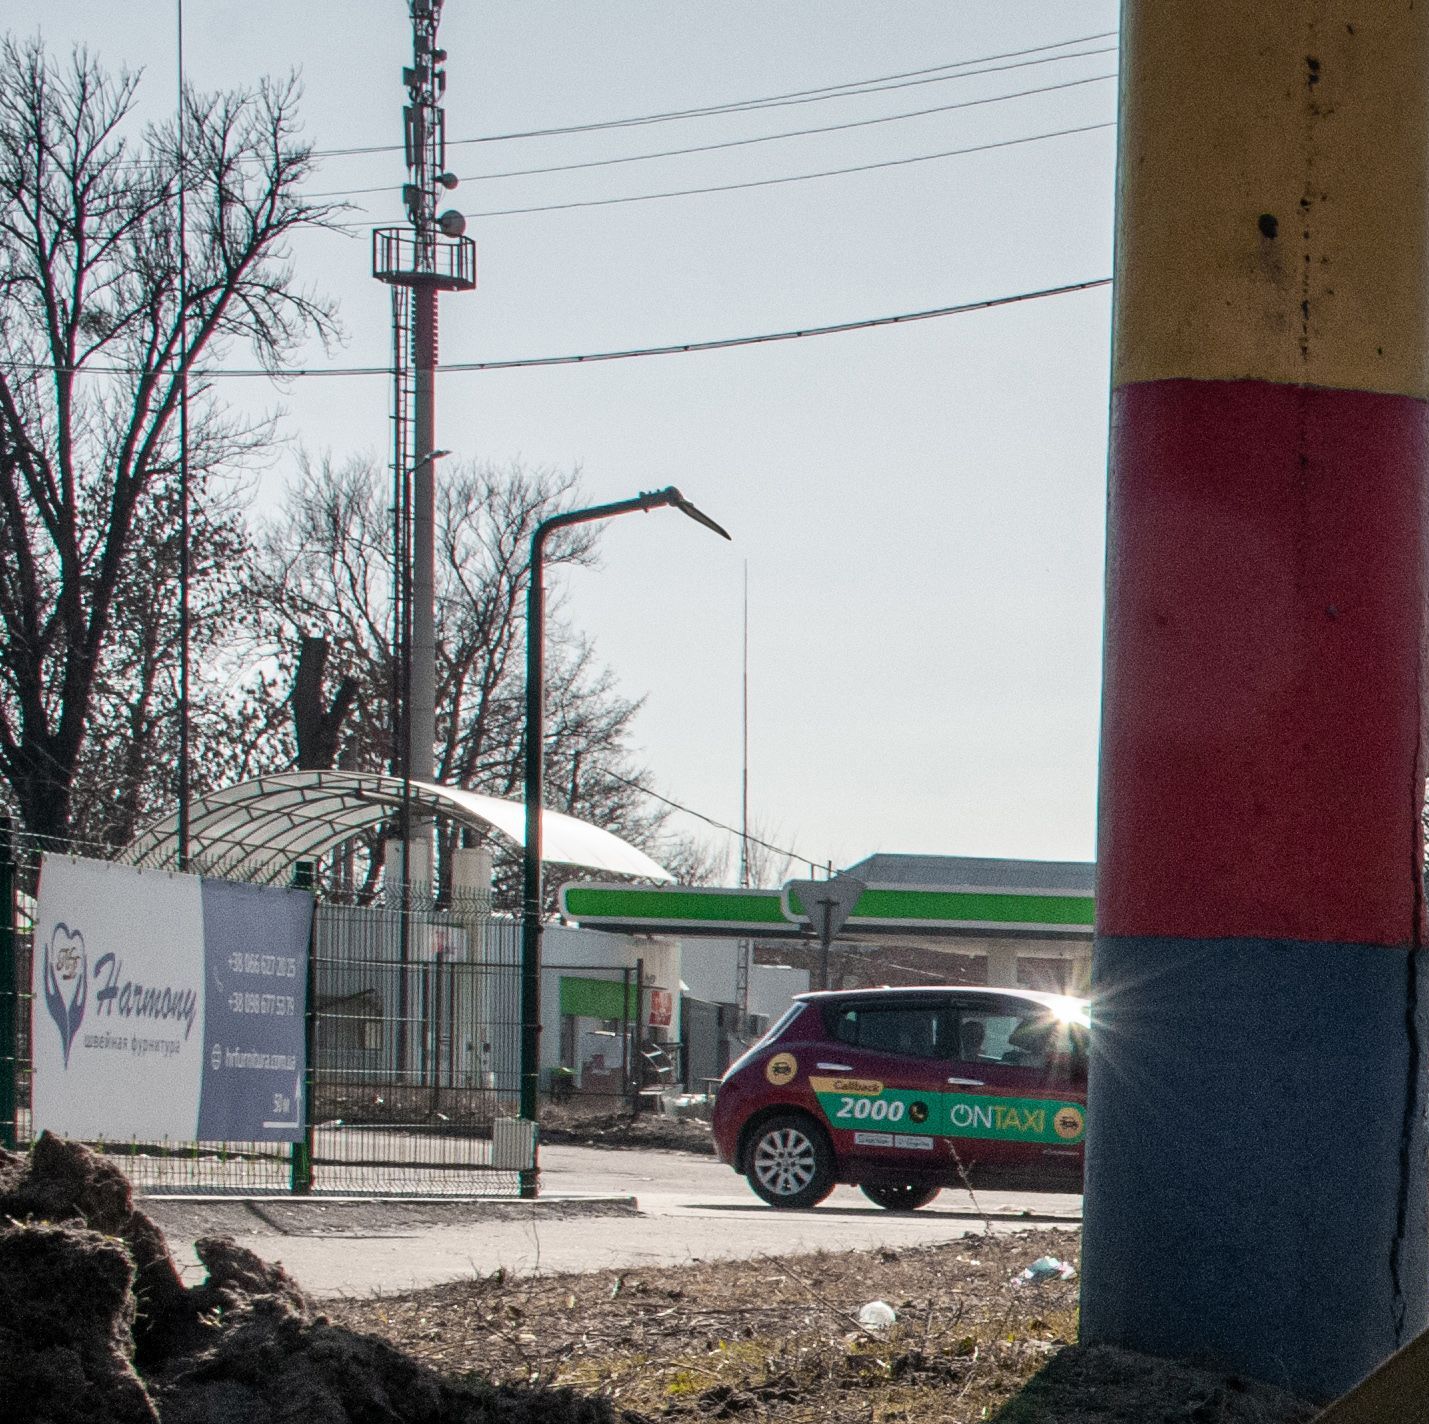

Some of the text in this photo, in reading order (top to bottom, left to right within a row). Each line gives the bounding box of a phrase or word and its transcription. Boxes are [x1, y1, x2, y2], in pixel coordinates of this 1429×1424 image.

[93, 952, 197, 1040] Harmony
[84, 1031, 128, 1051] швейная
[833, 1080, 880, 1093] Callback
[836, 1097, 905, 1122] 2000
